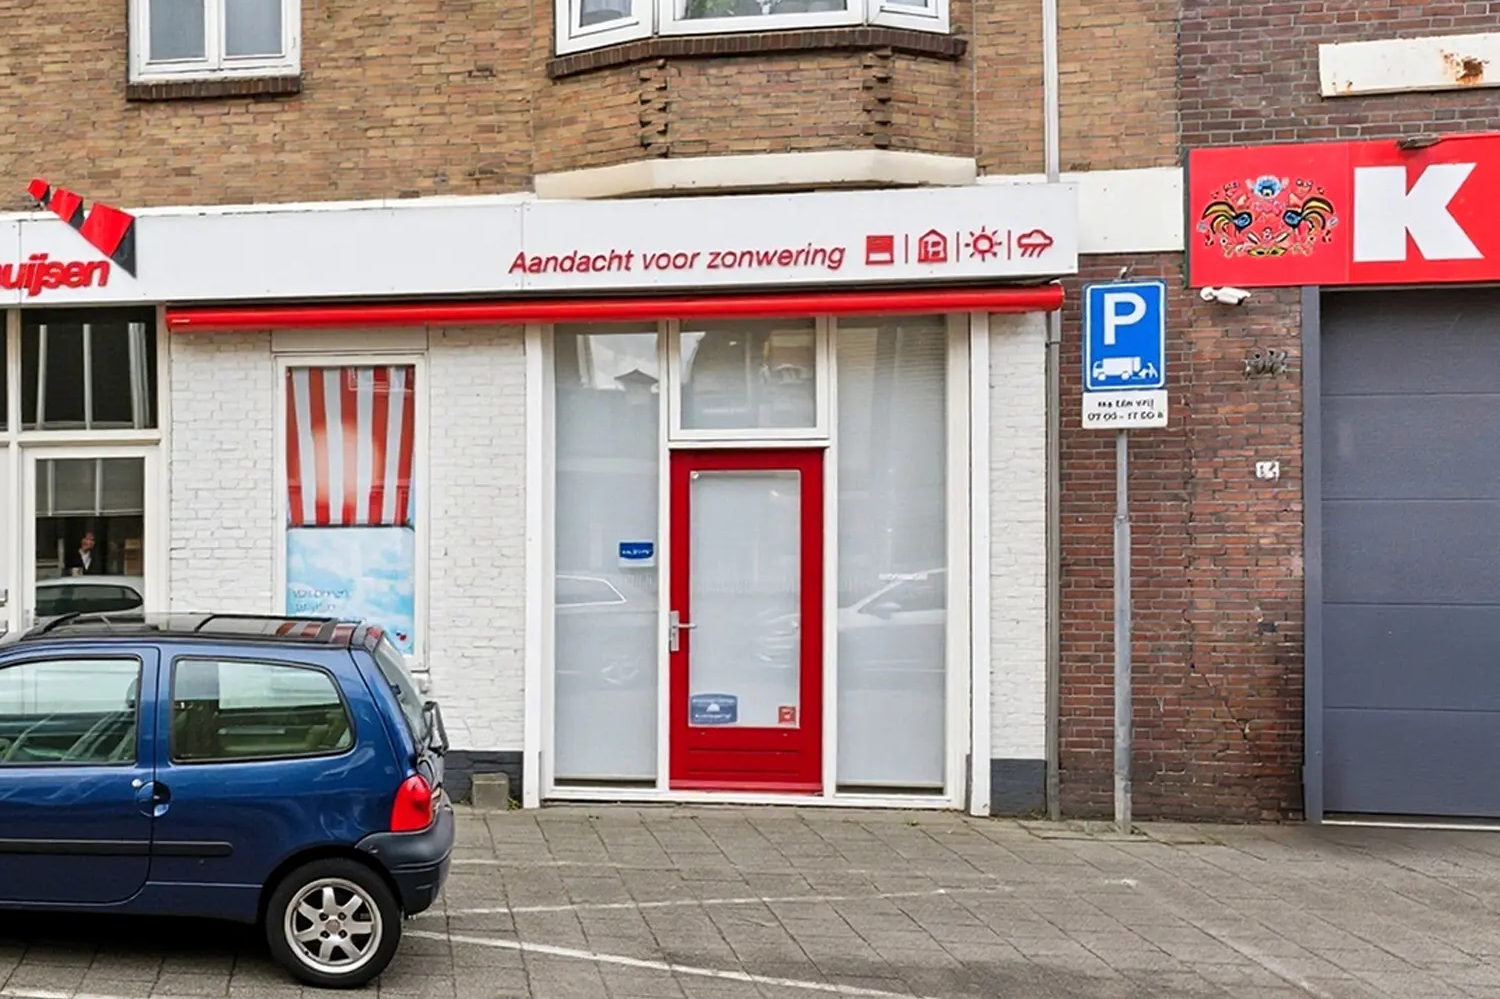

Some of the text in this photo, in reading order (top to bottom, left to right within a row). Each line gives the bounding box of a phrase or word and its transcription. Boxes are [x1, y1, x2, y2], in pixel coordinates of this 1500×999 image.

[1353, 162, 1485, 263] K
[508, 243, 847, 274] Aandacht voor zonwering
[1104, 292, 1147, 346] P
